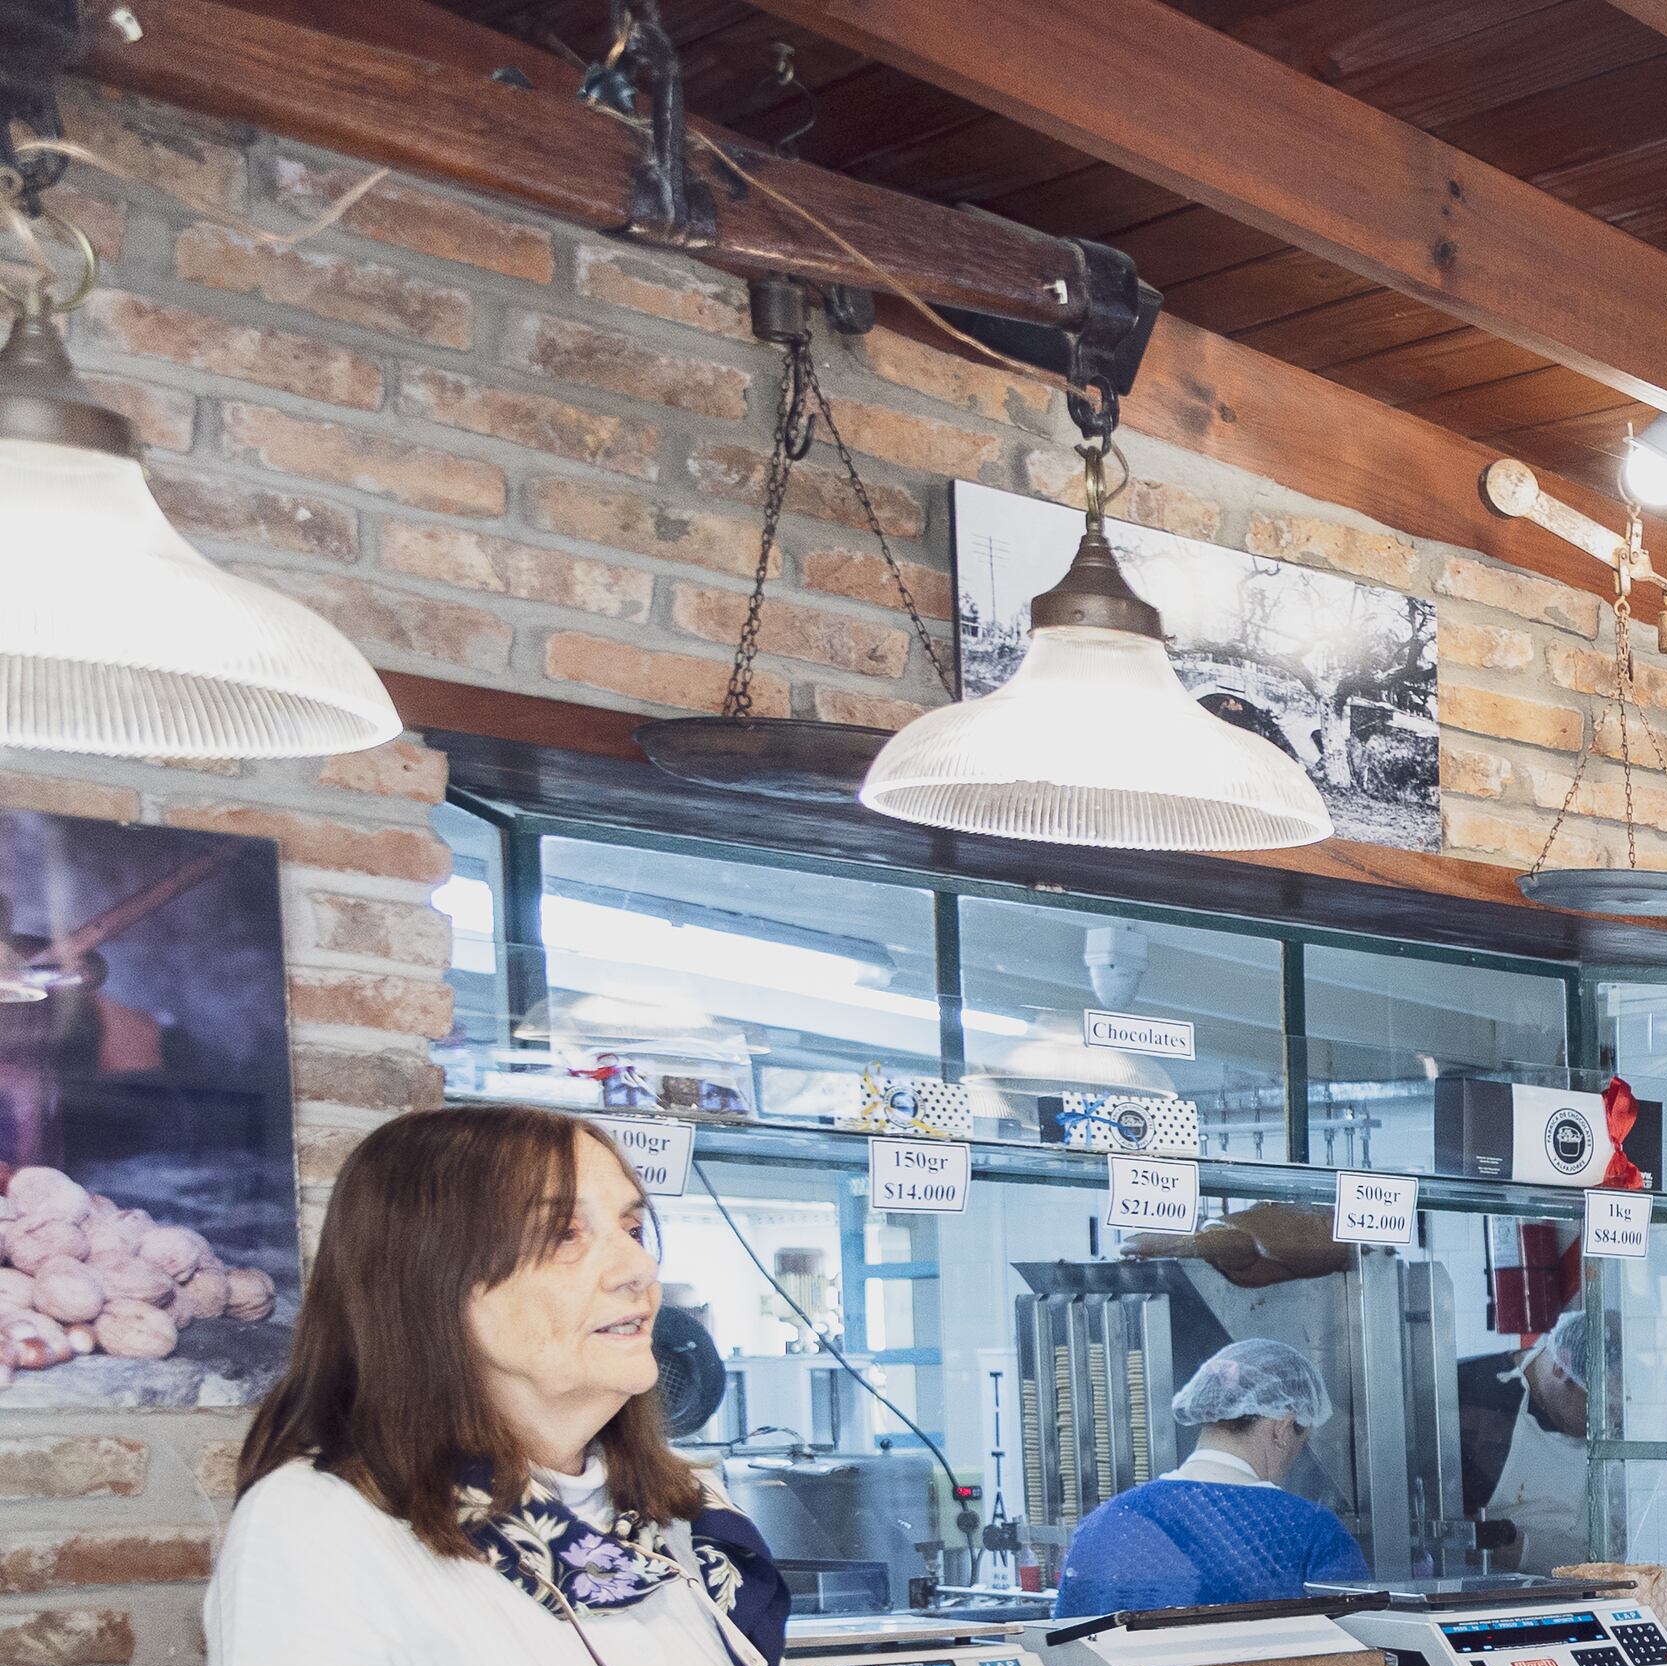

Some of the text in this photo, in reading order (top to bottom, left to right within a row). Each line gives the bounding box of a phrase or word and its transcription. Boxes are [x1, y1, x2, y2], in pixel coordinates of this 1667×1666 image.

[1093, 1021, 1186, 1048] Chocolates
[895, 1151, 948, 1174] 150gr
[1131, 1168, 1179, 1192] 250gr
[884, 1182, 956, 1202] $14.000
[1356, 1185, 1400, 1206] 500gr
[1120, 1198, 1187, 1219] $21.000
[1609, 1203, 1632, 1222] 1kg
[1347, 1212, 1405, 1231] $42.000
[1594, 1228, 1642, 1246] $84.000
[1617, 1612, 1636, 1620] LAP
